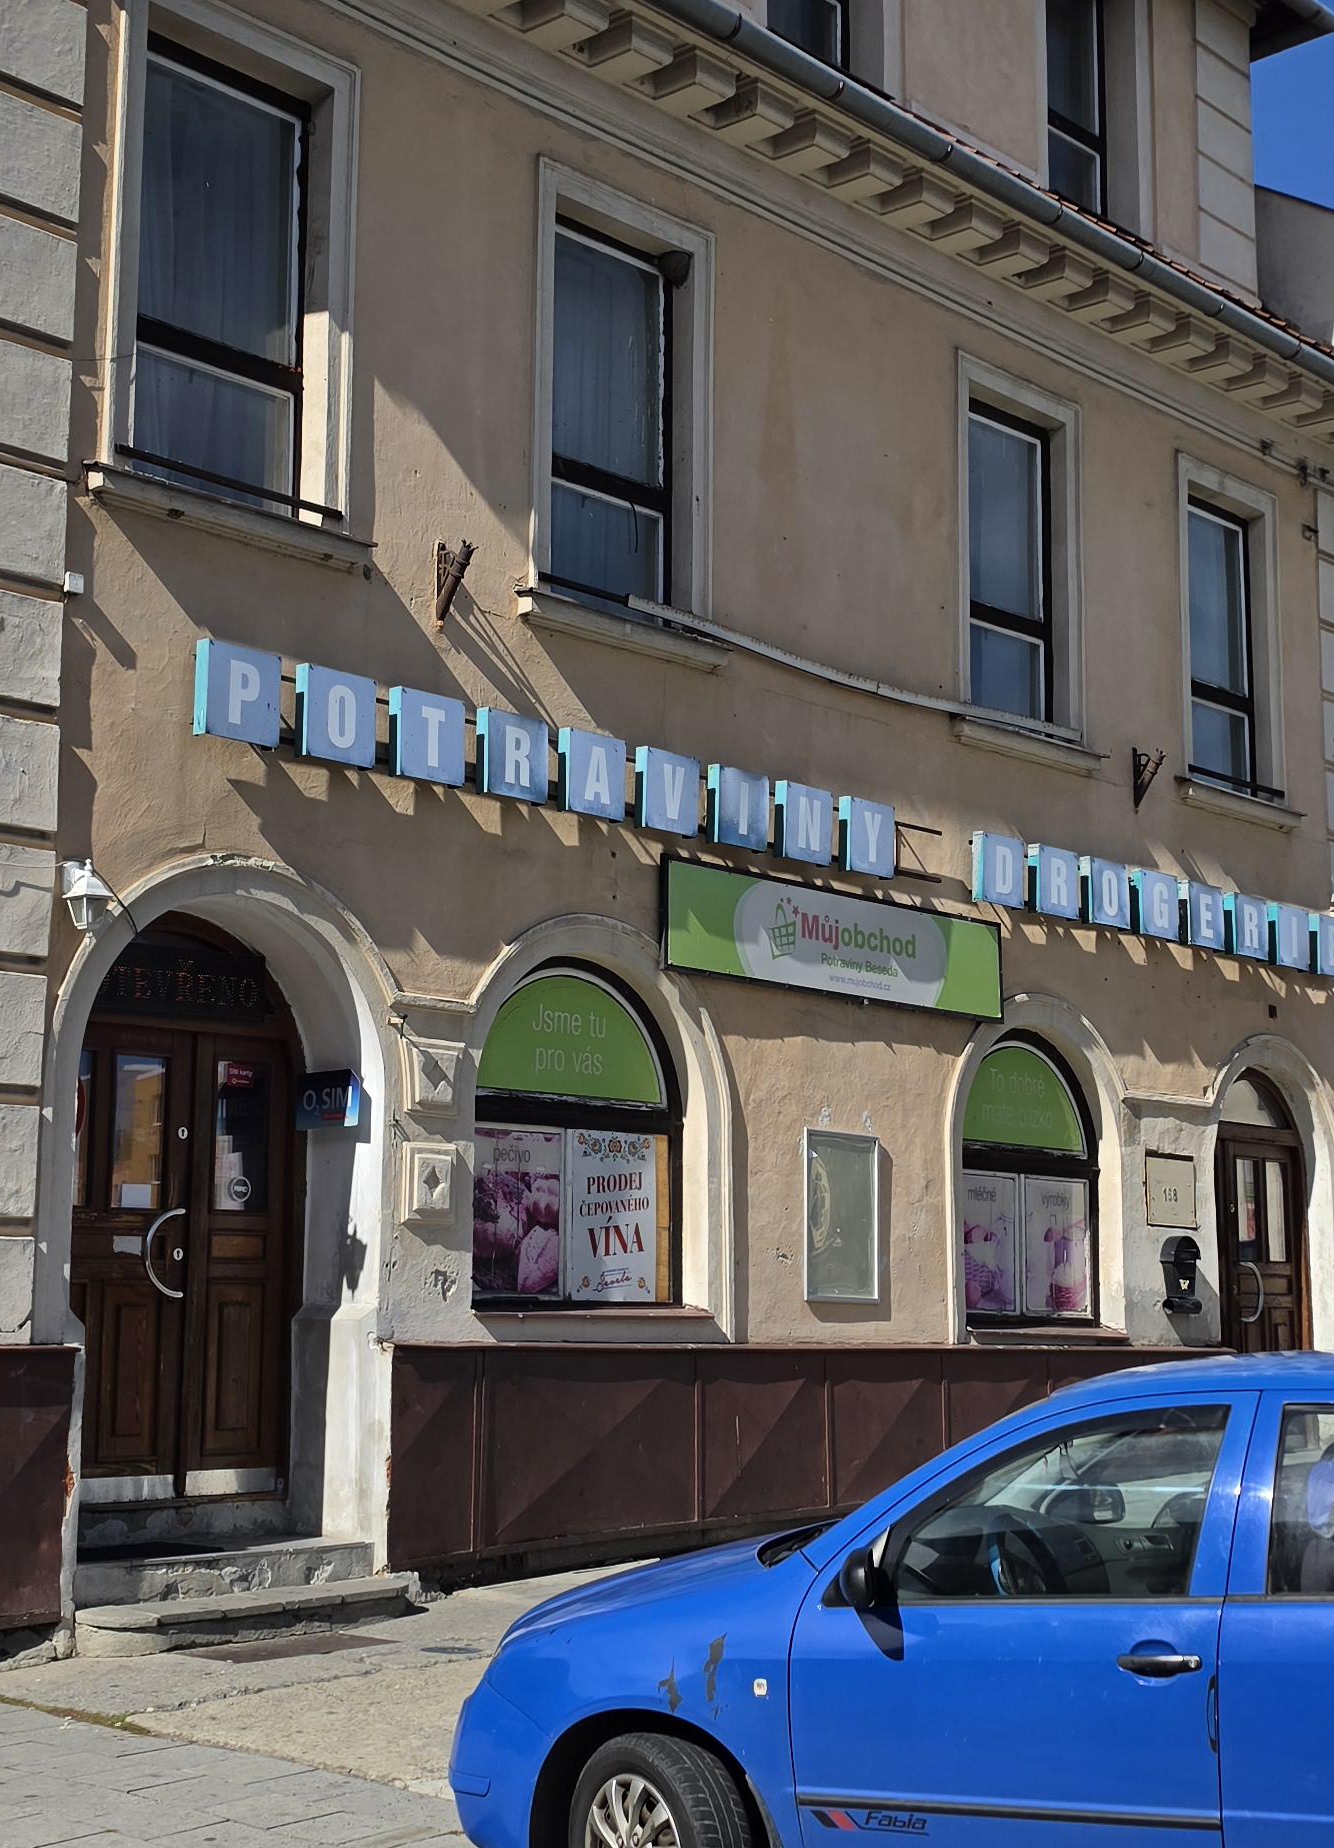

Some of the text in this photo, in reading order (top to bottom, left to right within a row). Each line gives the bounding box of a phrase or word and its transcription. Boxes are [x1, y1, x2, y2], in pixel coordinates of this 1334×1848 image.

[228, 658, 884, 865] POTRAVINY
[800, 911, 917, 959] Můjobchod
[820, 952, 899, 978] Potraviny Beseda
[532, 1002, 606, 1039] Jsme tu
[535, 1044, 604, 1077] pro vás
[988, 1067, 1005, 1094] To
[320, 1085, 352, 1110] SIM
[492, 1143, 531, 1165] pečivo
[586, 1170, 644, 1196] PRODEJ
[967, 1185, 997, 1203] mléčné
[579, 1194, 650, 1218] ČEPOVANÉHO
[587, 1215, 645, 1259] VÍNA
[864, 1810, 928, 1831] Fabia
